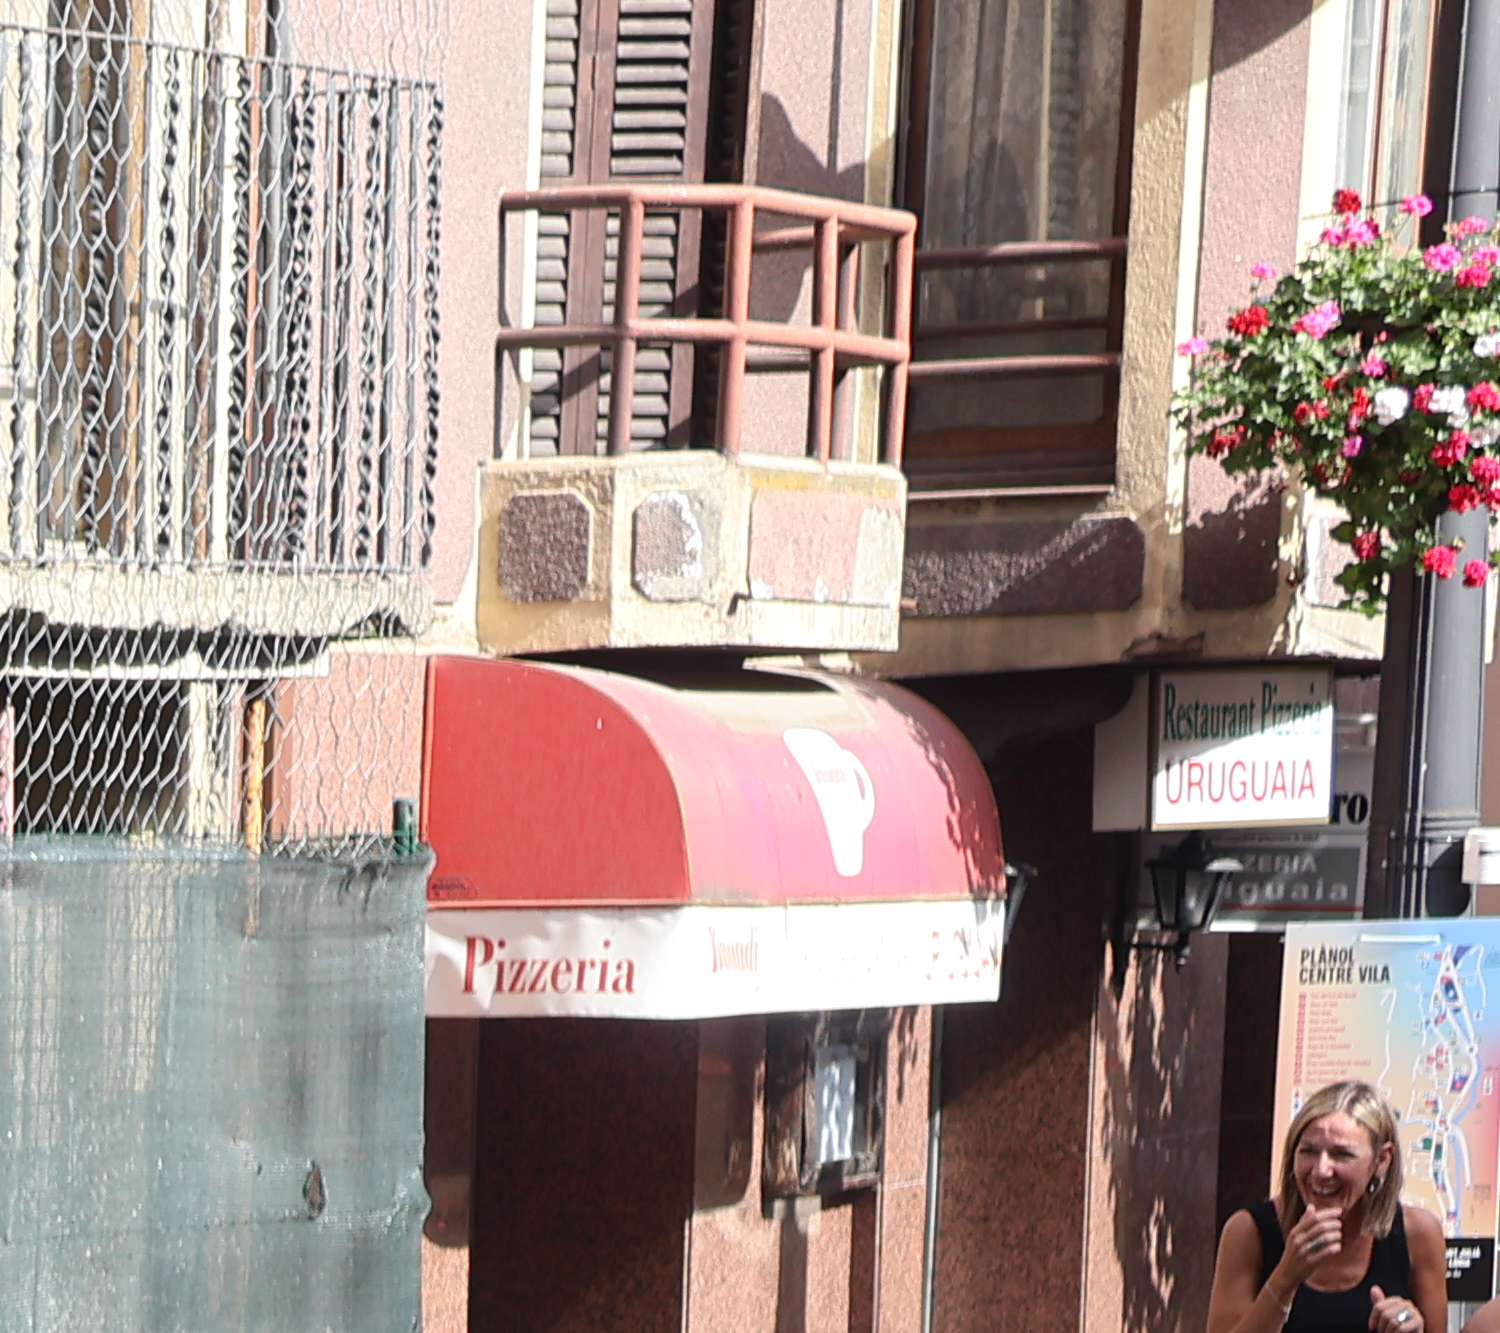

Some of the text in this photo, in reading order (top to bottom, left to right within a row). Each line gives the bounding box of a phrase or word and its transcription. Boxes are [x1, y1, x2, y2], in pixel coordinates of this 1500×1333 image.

[1163, 681, 1322, 741] Restaurant Pizzeria
[1165, 760, 1315, 804] URUGUAIA
[1331, 792, 1368, 824] ro
[462, 936, 635, 995] Pizzeria
[1300, 964, 1390, 984] CENTRE VILA
